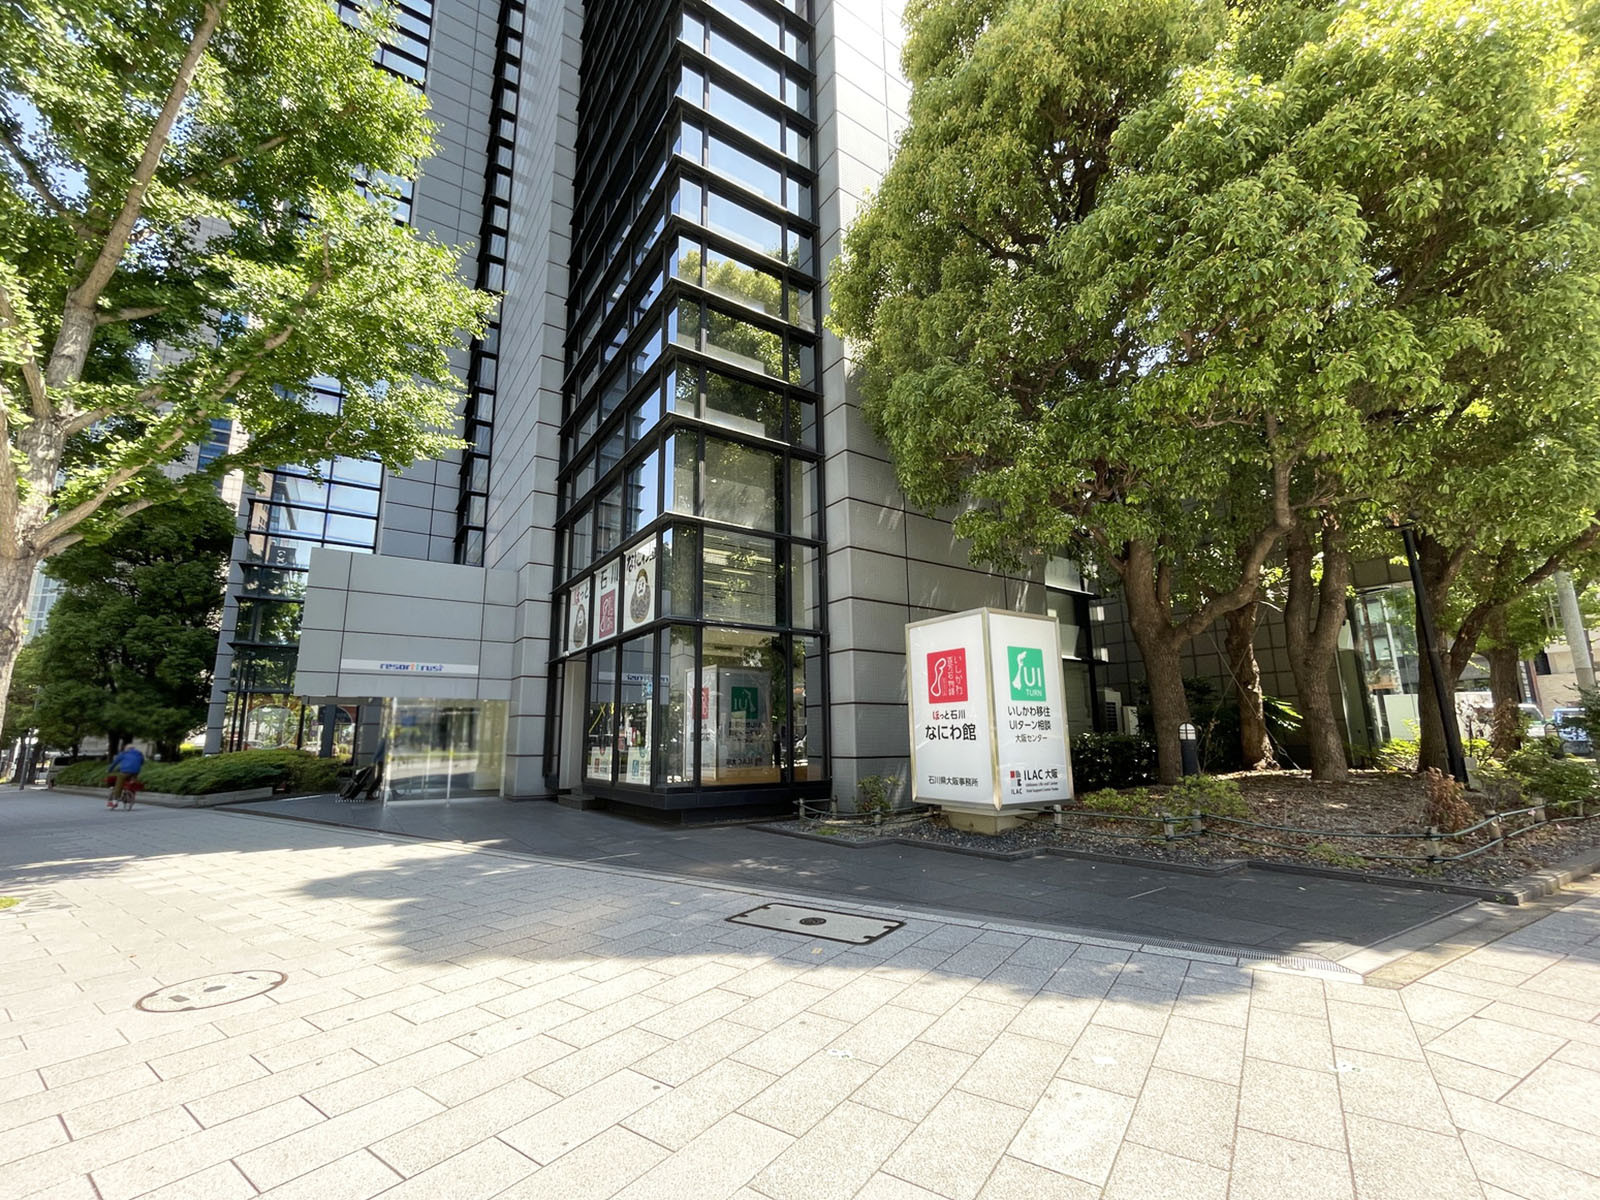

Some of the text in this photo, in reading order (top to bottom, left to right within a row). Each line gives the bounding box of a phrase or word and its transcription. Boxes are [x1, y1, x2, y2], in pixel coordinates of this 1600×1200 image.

[953, 655, 964, 696] いしかわ
[1023, 666, 1042, 687] UI
[1025, 688, 1042, 697] TURN
[932, 709, 966, 720] ほっと石川
[1007, 706, 1051, 717] いしかわ移住
[1009, 720, 1052, 731] UIターン相談
[925, 723, 977, 741] なにわ館
[1015, 734, 1048, 743] 大阪センター
[1023, 768, 1058, 780] ILAC 大阪
[928, 775, 979, 787] 石川県大阪事務所
